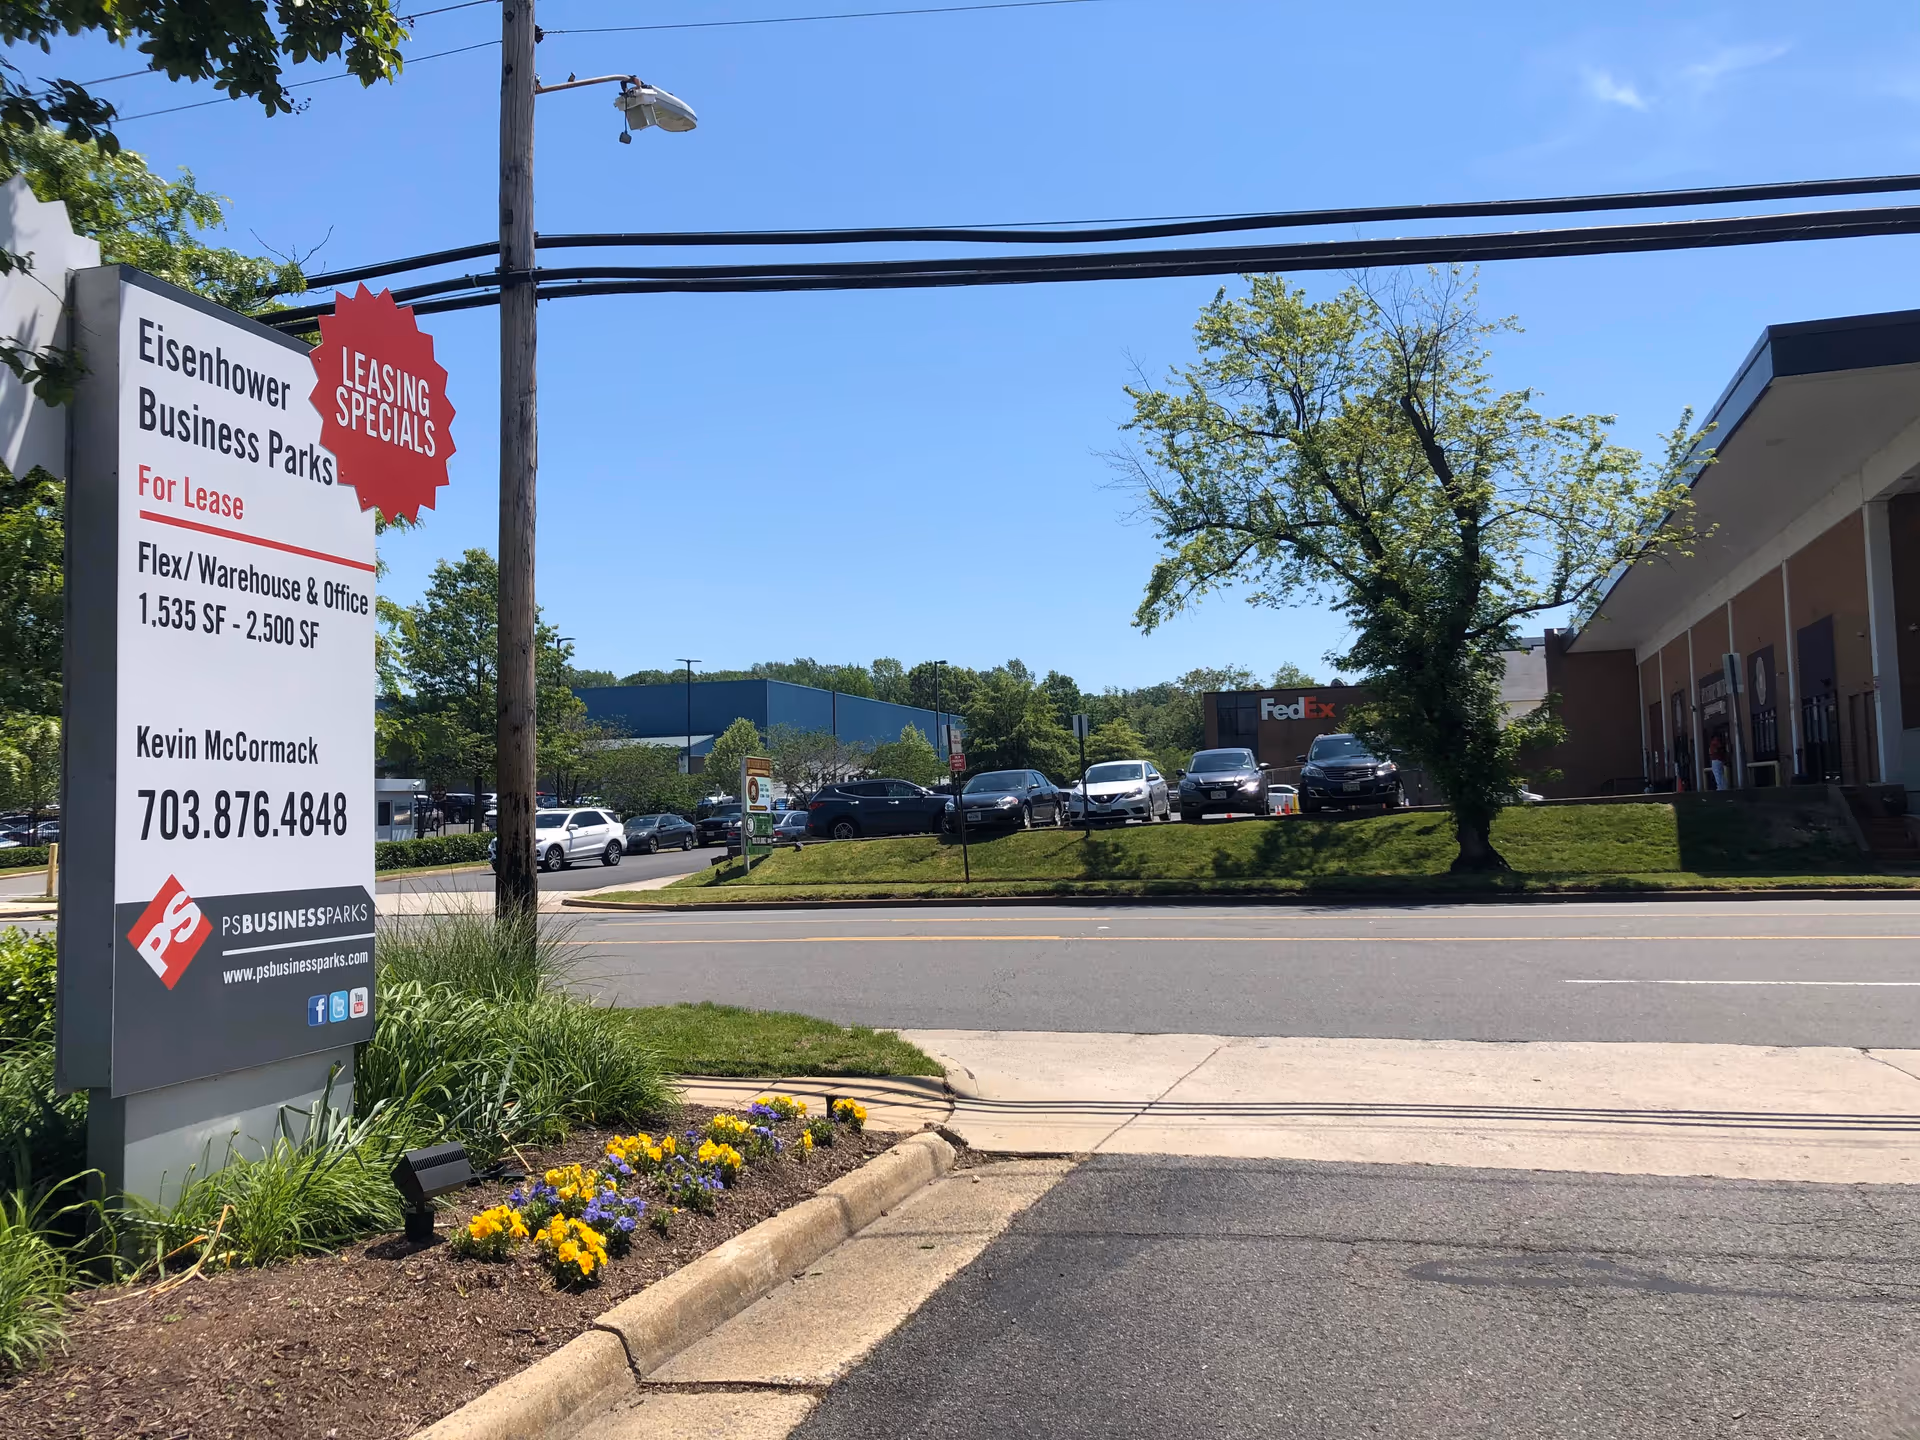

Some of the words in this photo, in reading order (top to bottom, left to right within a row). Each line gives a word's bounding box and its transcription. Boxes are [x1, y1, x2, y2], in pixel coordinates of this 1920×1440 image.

[138, 317, 291, 411] Eisenhower
[341, 346, 430, 418] LEASING
[138, 386, 260, 463] Business
[268, 429, 334, 486] Parks
[335, 387, 436, 458] SPECIALS
[138, 464, 177, 503] For
[184, 476, 244, 520] Lease
[138, 592, 196, 632] 1,535
[202, 603, 227, 635] SF
[246, 610, 295, 645] 2,500
[299, 619, 320, 649] SF
[306, 576, 318, 605] &
[323, 581, 369, 616] Office
[1260, 696, 1336, 720] FedEx
[136, 725, 197, 760] Kevin
[204, 729, 319, 765] McCormack
[137, 789, 348, 841] 703.876.4848
[137, 890, 201, 979] PS
[223, 951, 369, 984] www.psbusinessparks.com
